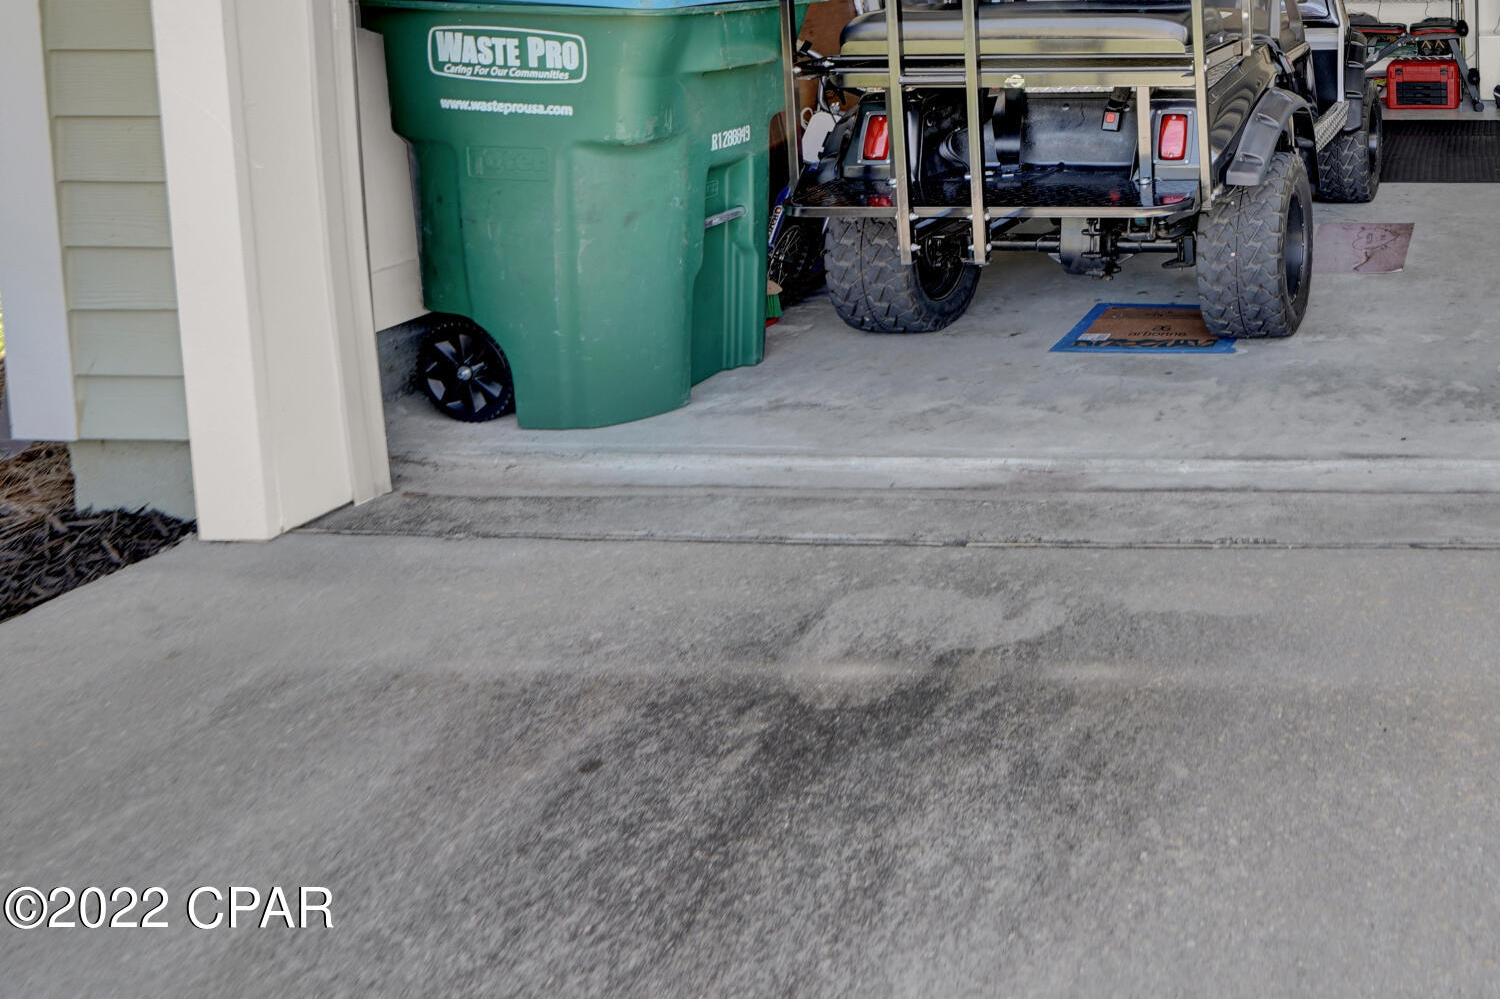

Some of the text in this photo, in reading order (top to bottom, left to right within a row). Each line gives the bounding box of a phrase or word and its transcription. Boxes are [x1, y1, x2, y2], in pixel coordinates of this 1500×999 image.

[435, 31, 579, 70] WASTE PRO
[444, 63, 569, 80] Caring For Our Communities
[439, 98, 573, 116] www.wasteprousa.com
